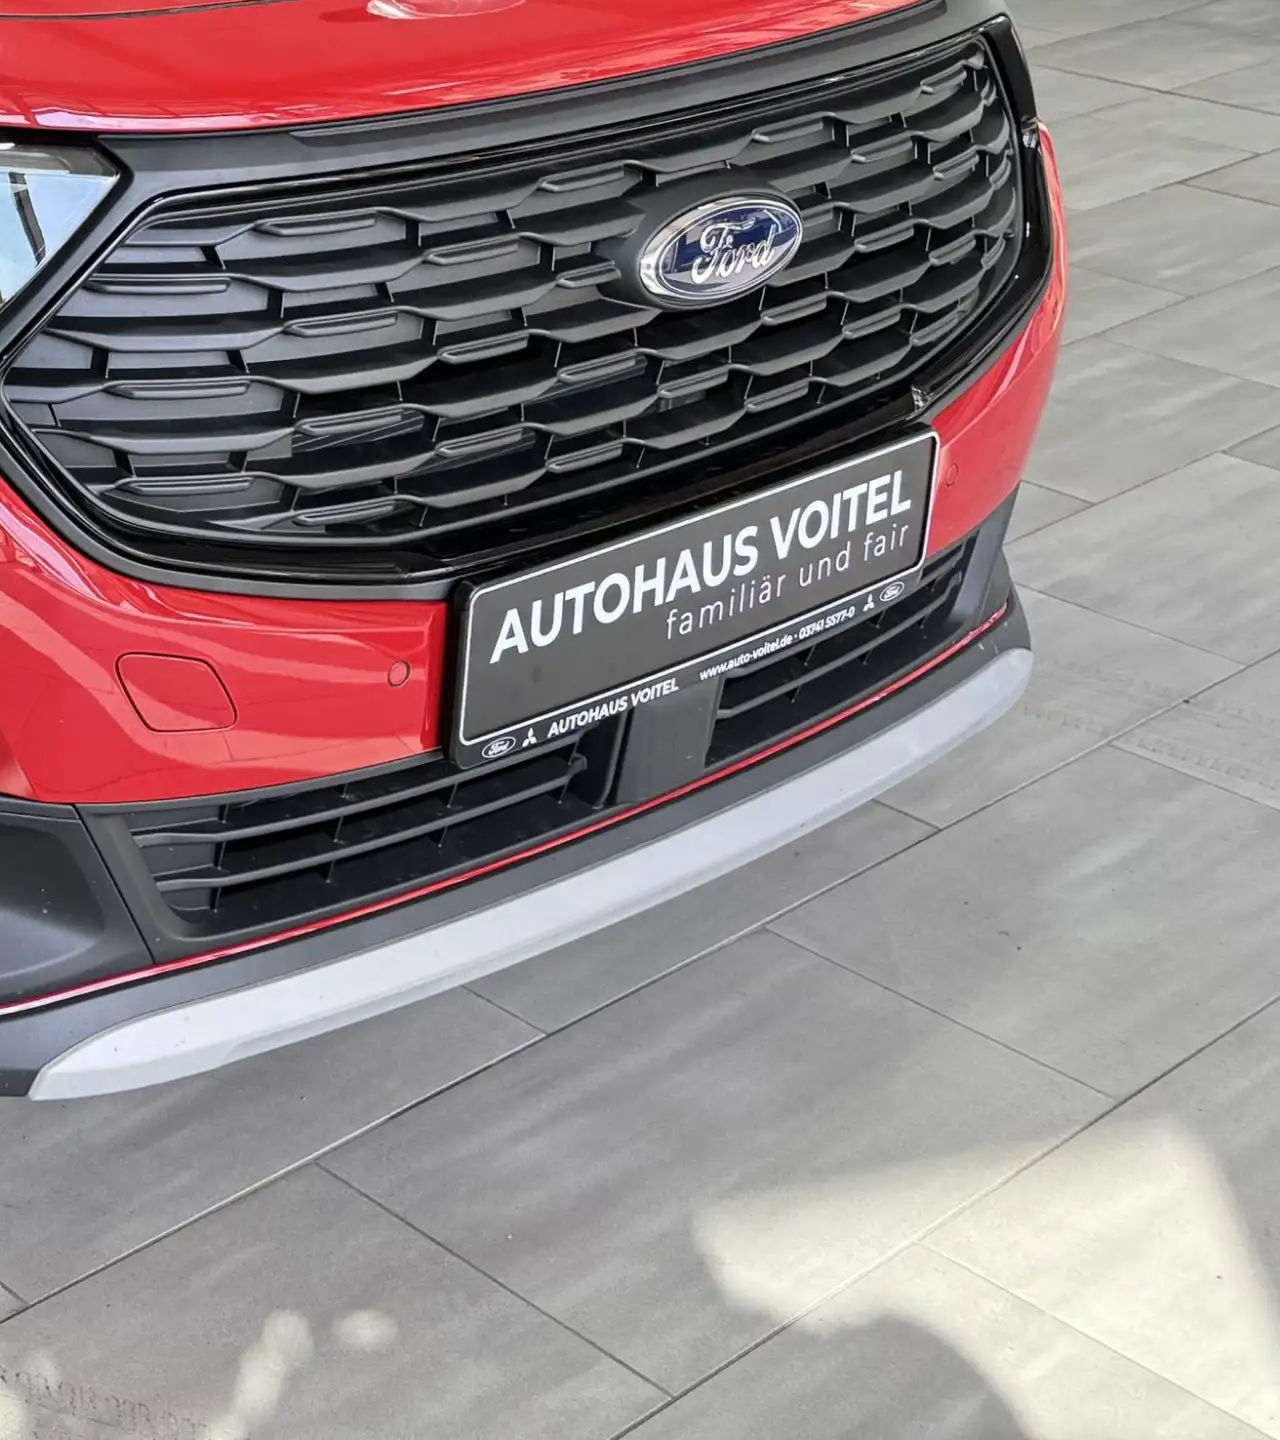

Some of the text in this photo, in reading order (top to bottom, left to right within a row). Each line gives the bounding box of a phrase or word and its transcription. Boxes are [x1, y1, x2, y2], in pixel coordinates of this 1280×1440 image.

[691, 216, 778, 285] Ford
[489, 469, 912, 664] AUTOHAUS VOITEL
[665, 521, 910, 640] familiär und fair
[547, 697, 628, 738] AUTOHAUS
[630, 677, 679, 707] VOITEL
[699, 634, 793, 681] www.auto-voitel.de
